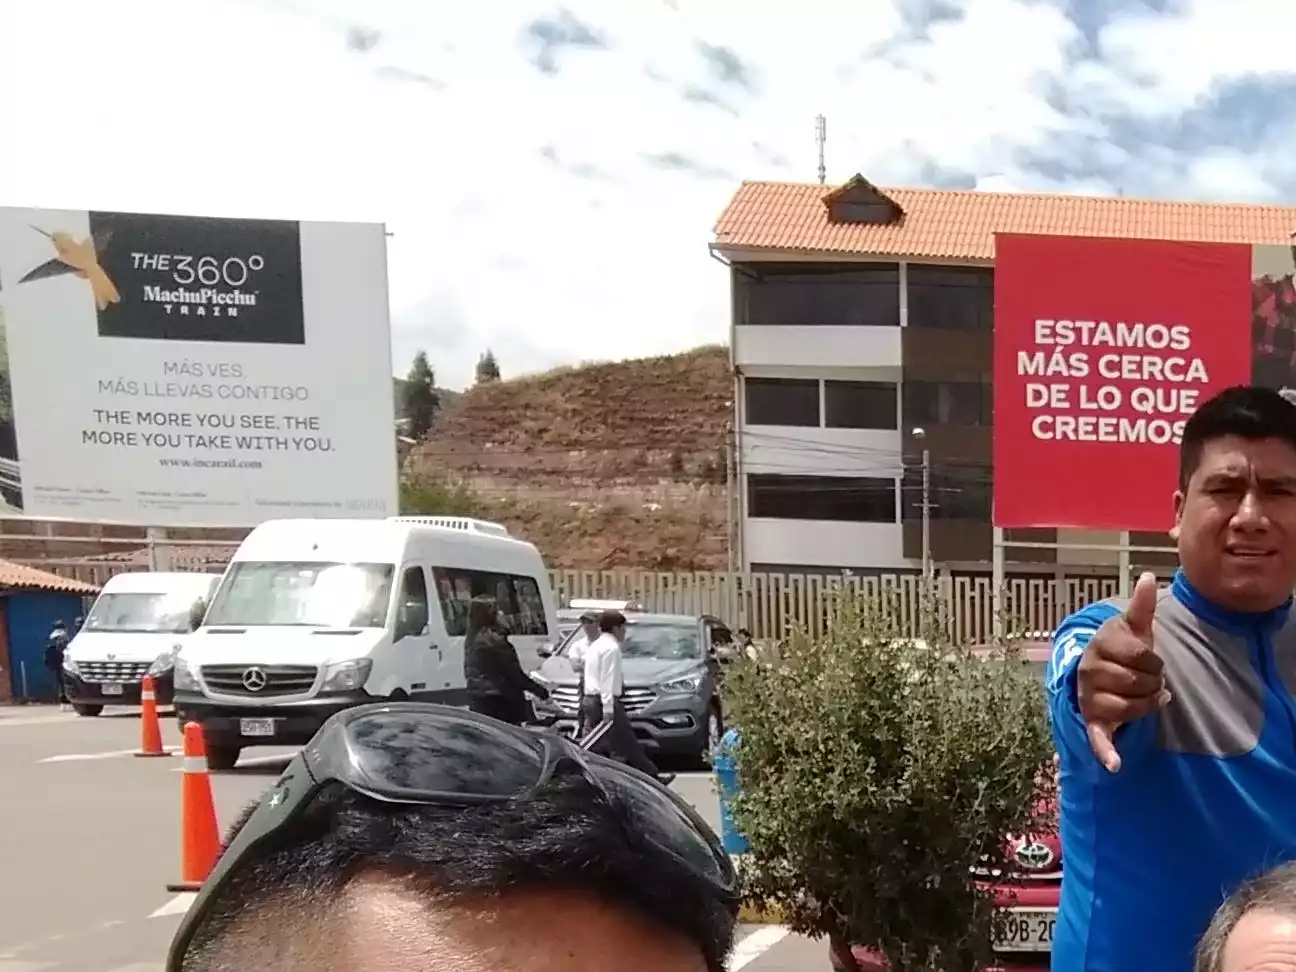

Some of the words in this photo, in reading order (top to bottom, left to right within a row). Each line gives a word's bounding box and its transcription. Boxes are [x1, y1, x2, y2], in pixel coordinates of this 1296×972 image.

[131, 252, 171, 271] THE
[164, 304, 239, 317] TRAIN
[1034, 319, 1191, 350] ESTAMOS
[163, 358, 204, 378] MÁS
[206, 362, 248, 378] VES.
[1016, 346, 1090, 378] MÁS
[1098, 354, 1209, 383] CERCA
[97, 376, 139, 396] MÁS
[143, 381, 214, 398] LLEVAS
[1026, 383, 1070, 408] DE
[1079, 385, 1122, 410] LO
[1130, 387, 1200, 414] QUE
[93, 409, 131, 425] THE
[136, 411, 192, 427] MORE
[196, 414, 236, 428] YOU
[283, 416, 320, 430] THE
[81, 430, 138, 446] MORE
[141, 432, 182, 448] YOU
[184, 433, 233, 450] TAKE
[235, 436, 289, 450] WITH
[291, 437, 336, 452] YOU.
